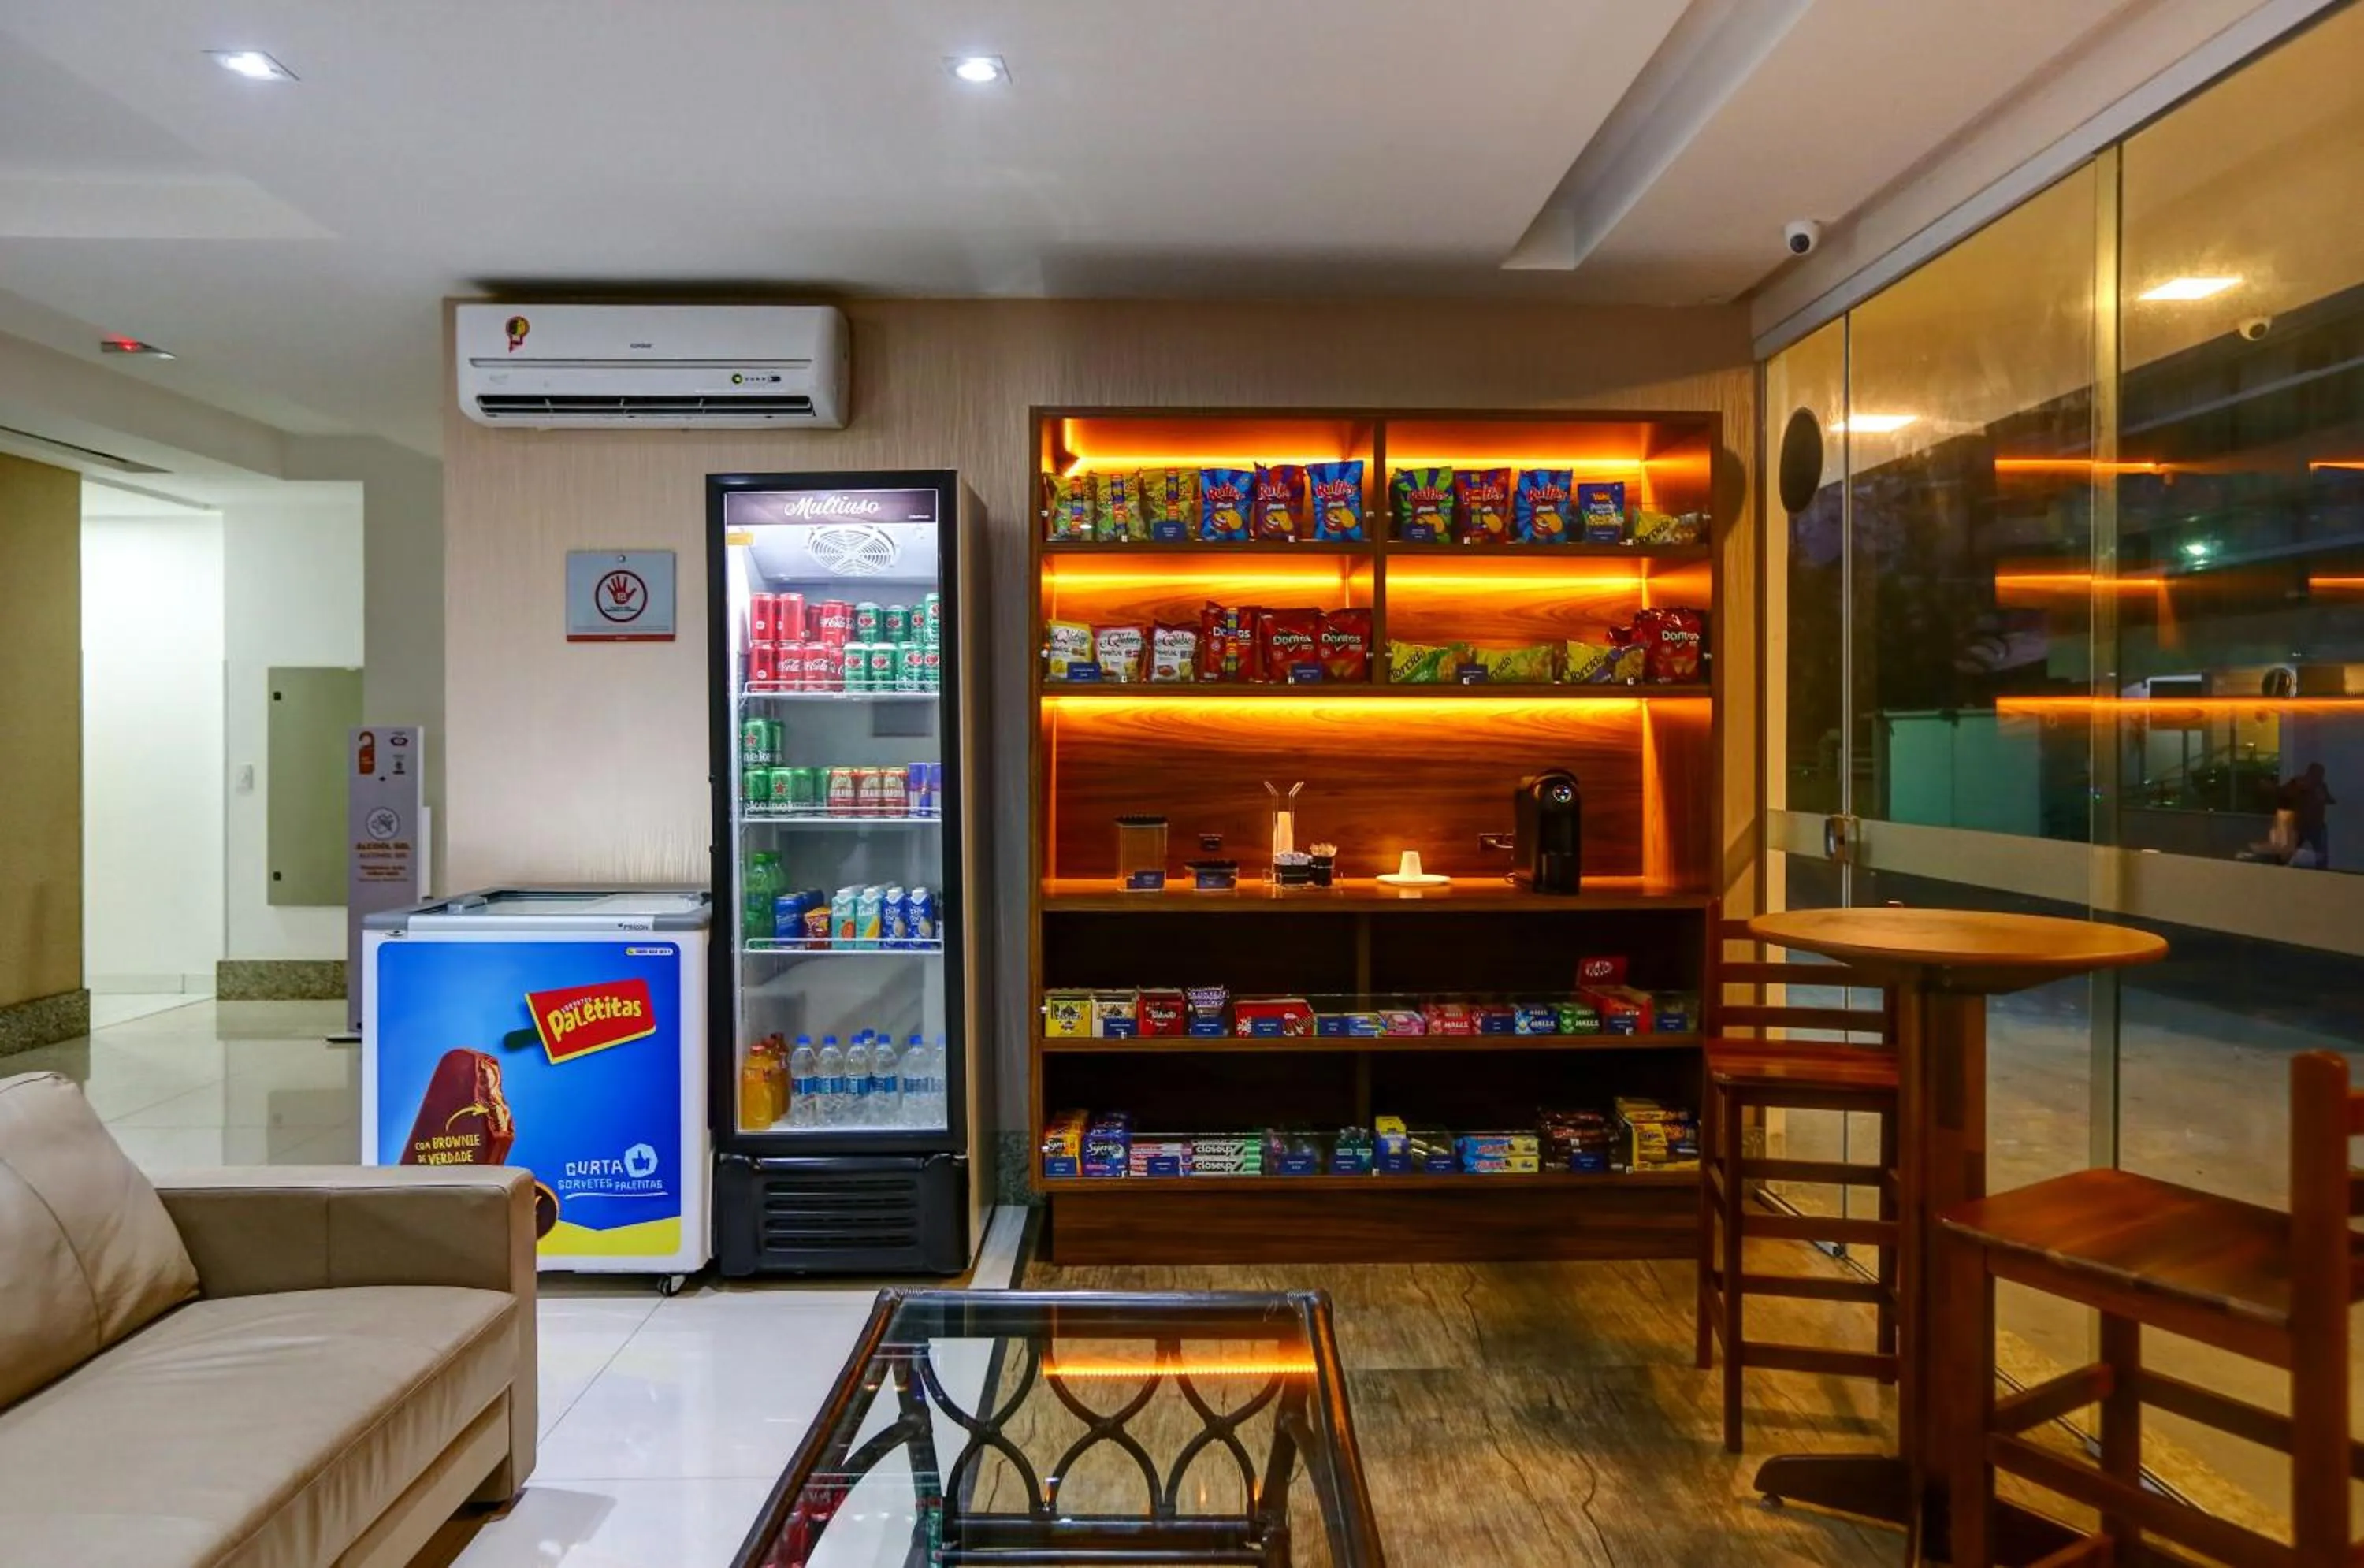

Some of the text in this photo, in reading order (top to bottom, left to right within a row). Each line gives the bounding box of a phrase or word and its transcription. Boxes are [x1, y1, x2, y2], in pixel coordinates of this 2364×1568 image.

[784, 496, 880, 519] Multiuso
[1321, 633, 1362, 645] Doritos
[432, 1134, 481, 1150] BROWNIE
[428, 1150, 474, 1165] VERDADE
[565, 1159, 623, 1176] CURTA
